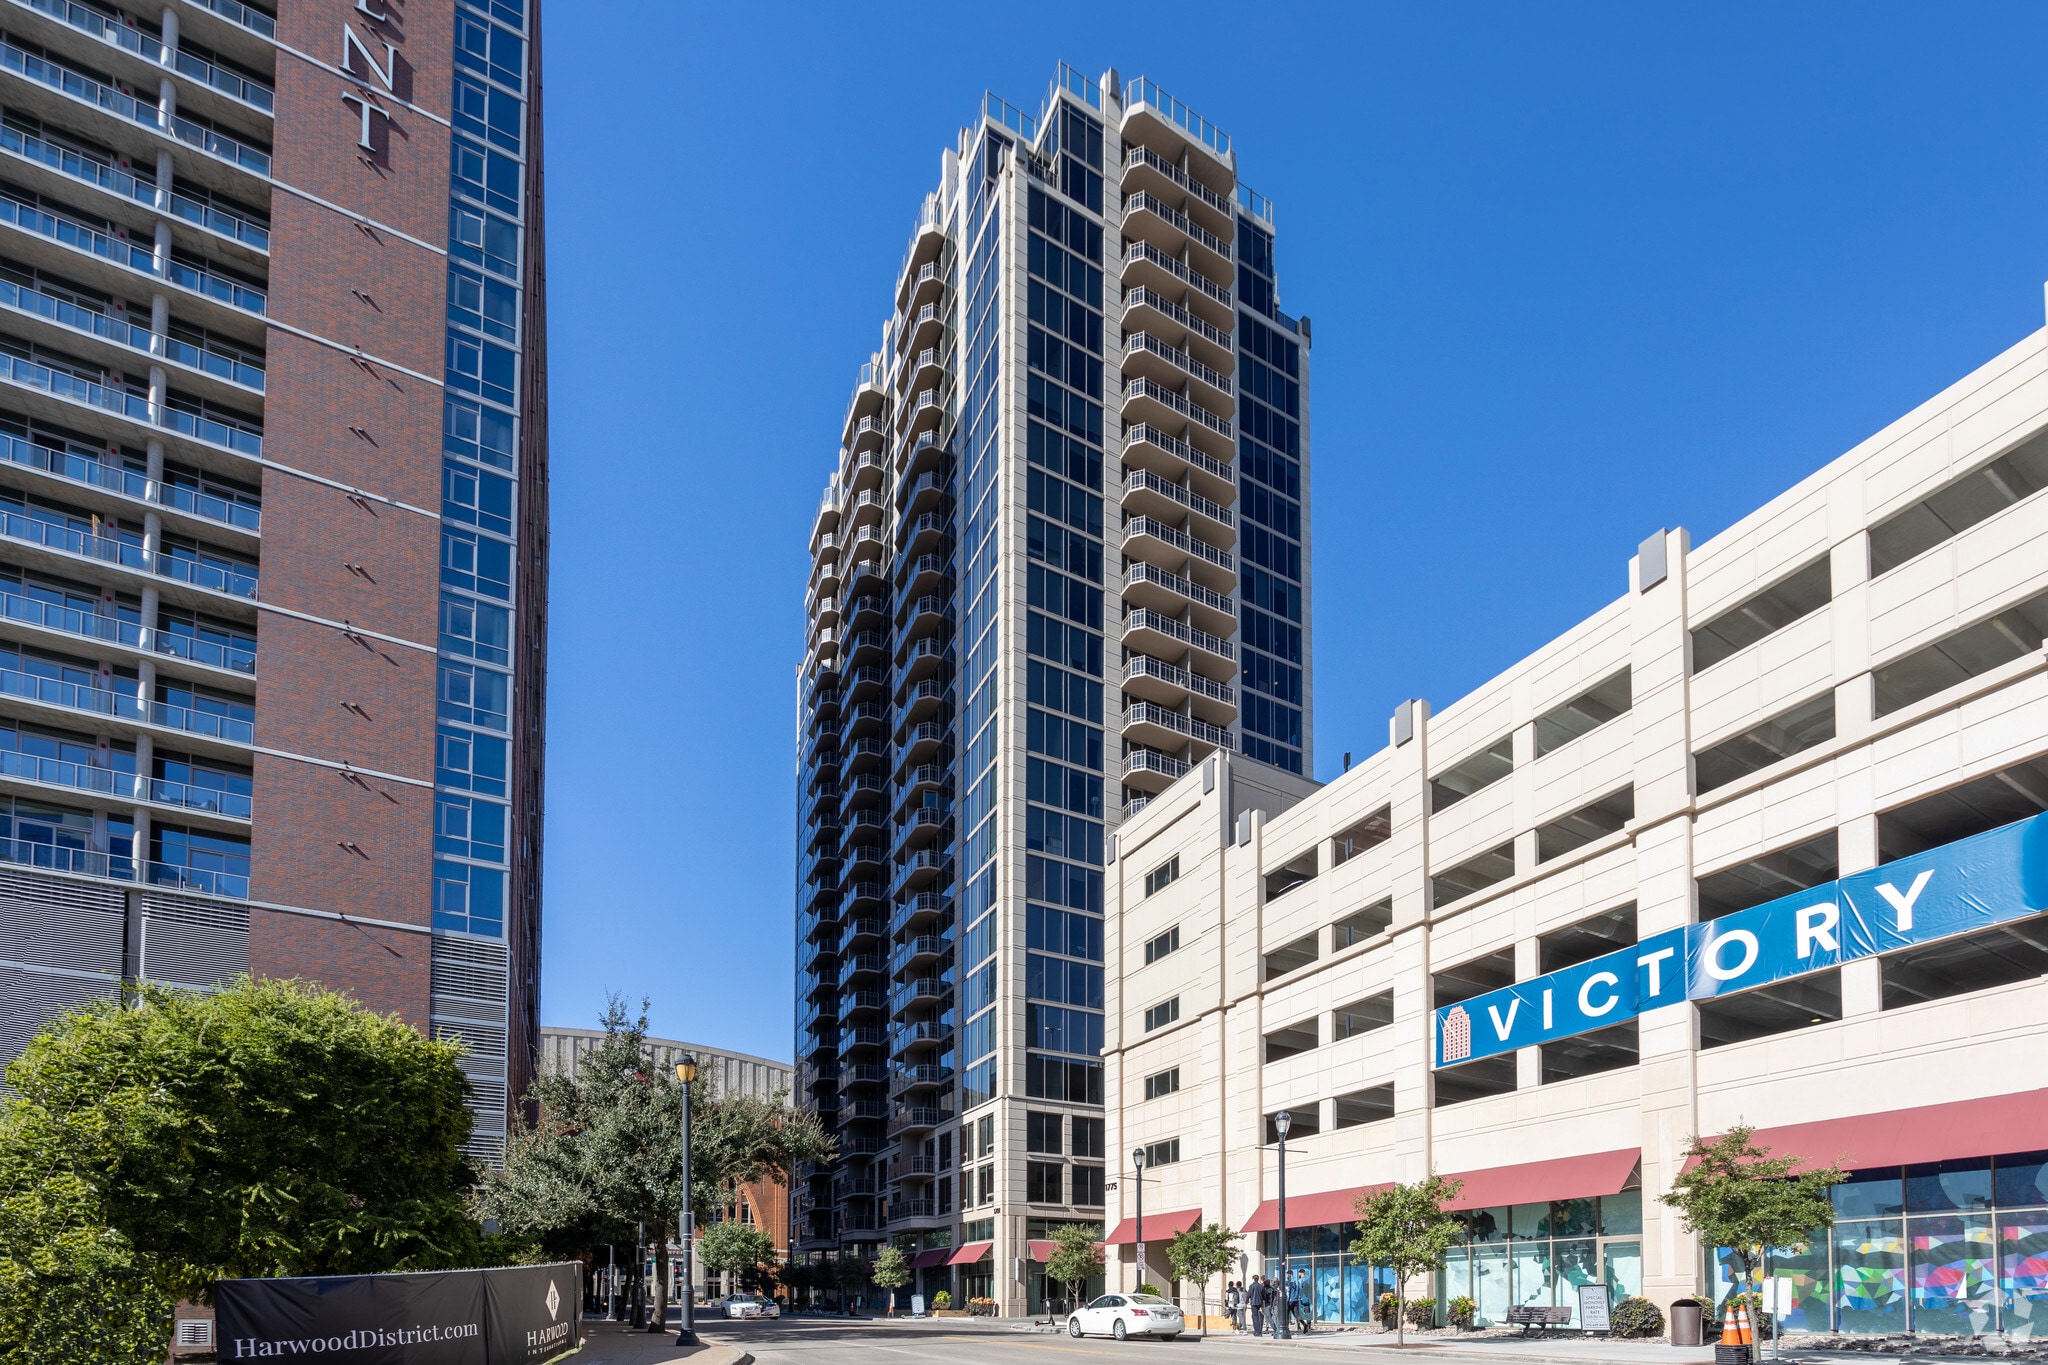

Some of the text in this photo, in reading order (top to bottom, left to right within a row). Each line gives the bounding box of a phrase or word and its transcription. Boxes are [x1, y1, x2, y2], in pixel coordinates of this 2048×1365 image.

[1487, 868, 1936, 1042] VICTORY
[1105, 1182, 1117, 1191] 1775
[234, 1323, 479, 1359] HarwoodDistrict.com
